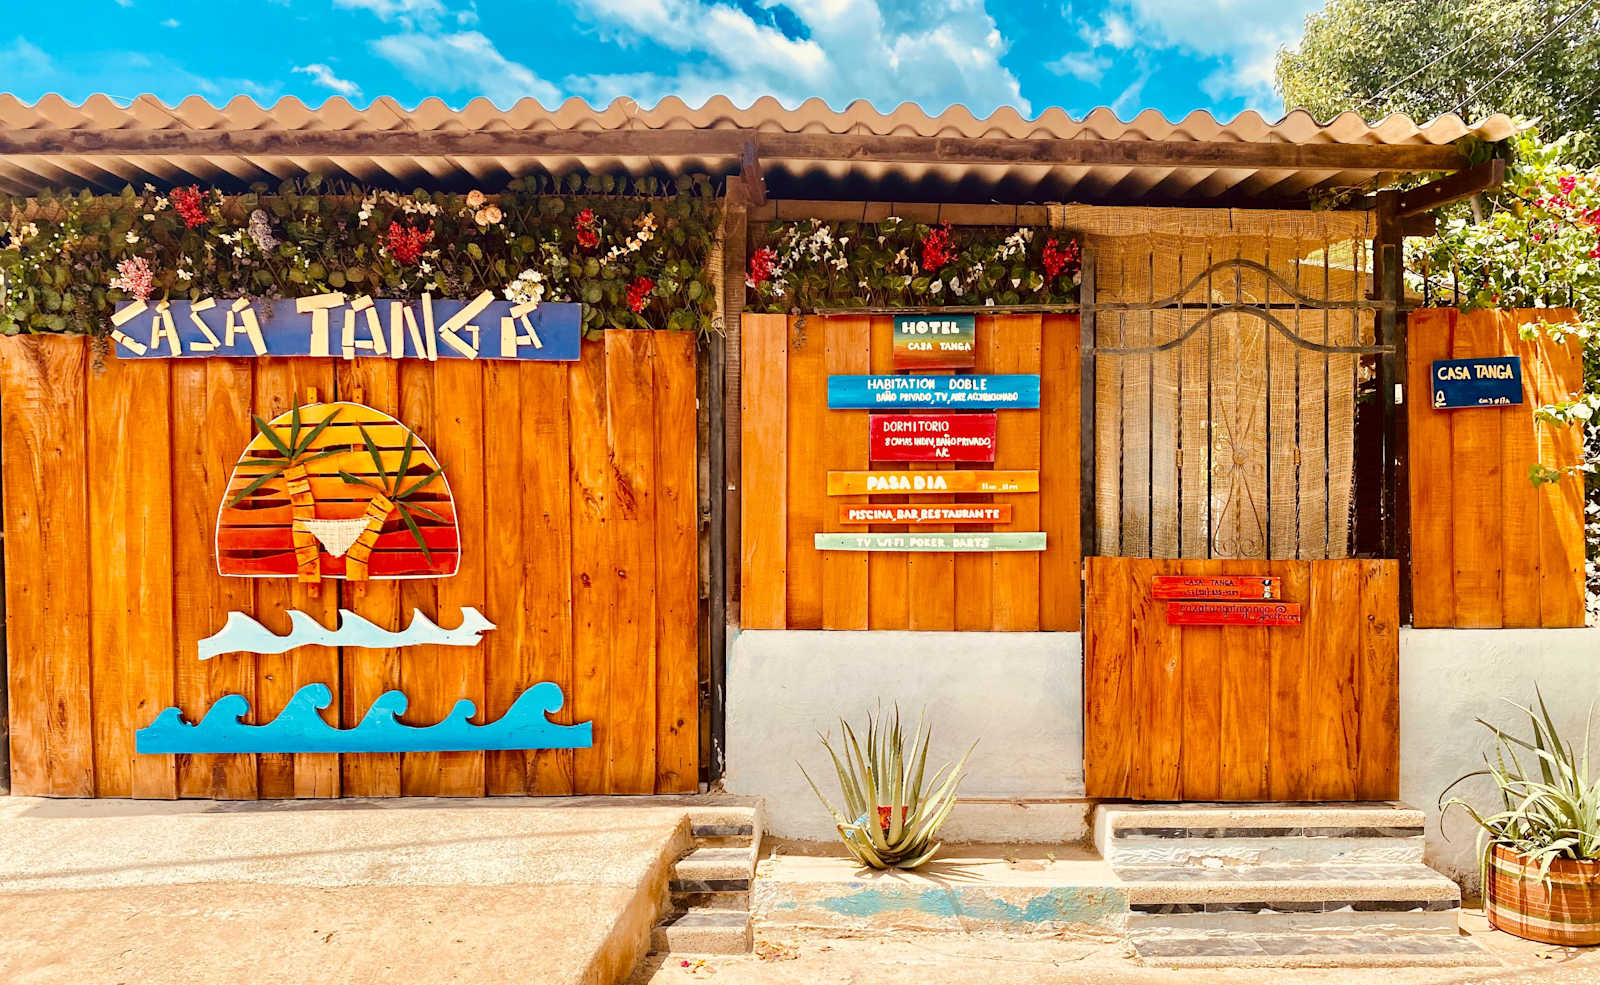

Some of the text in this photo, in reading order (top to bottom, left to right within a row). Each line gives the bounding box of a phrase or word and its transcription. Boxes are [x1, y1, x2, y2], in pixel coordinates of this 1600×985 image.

[110, 290, 543, 361] CASA TANGA
[901, 321, 960, 335] HOTEL
[907, 342, 971, 351] CASA TANGA
[1437, 363, 1514, 380] CASA TANGA
[949, 378, 988, 390] DOBLE
[883, 421, 950, 432] DORMITORIO
[867, 475, 947, 490] PASA DIA
[920, 508, 1000, 519] RESTAURANTE
[856, 537, 872, 547] TV
[952, 537, 991, 548] DARTS
